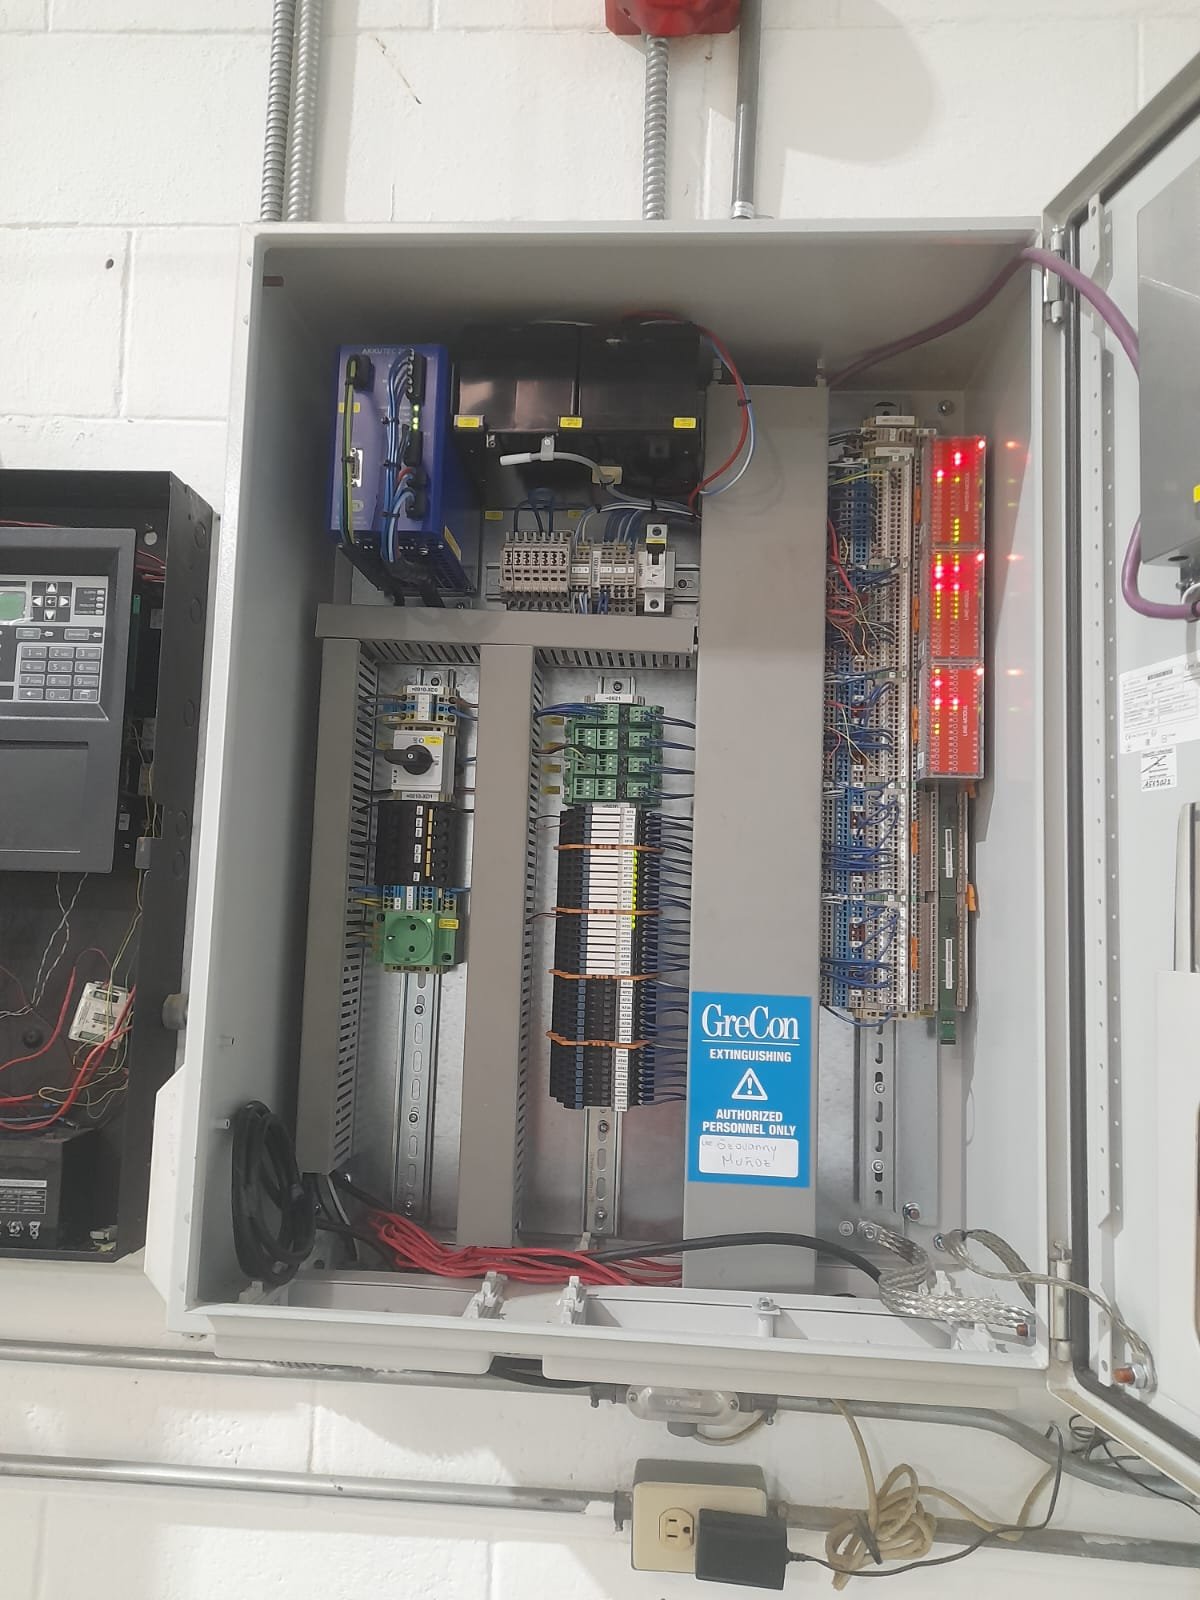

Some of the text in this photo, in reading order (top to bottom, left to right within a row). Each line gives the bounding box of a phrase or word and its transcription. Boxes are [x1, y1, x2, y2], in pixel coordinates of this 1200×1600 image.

[701, 1003, 800, 1040] GreCon
[709, 1048, 792, 1062] EXTINGUISHING
[716, 1109, 783, 1122] AUTHORIZED
[702, 1121, 796, 1136] PERSONNEL ONLY
